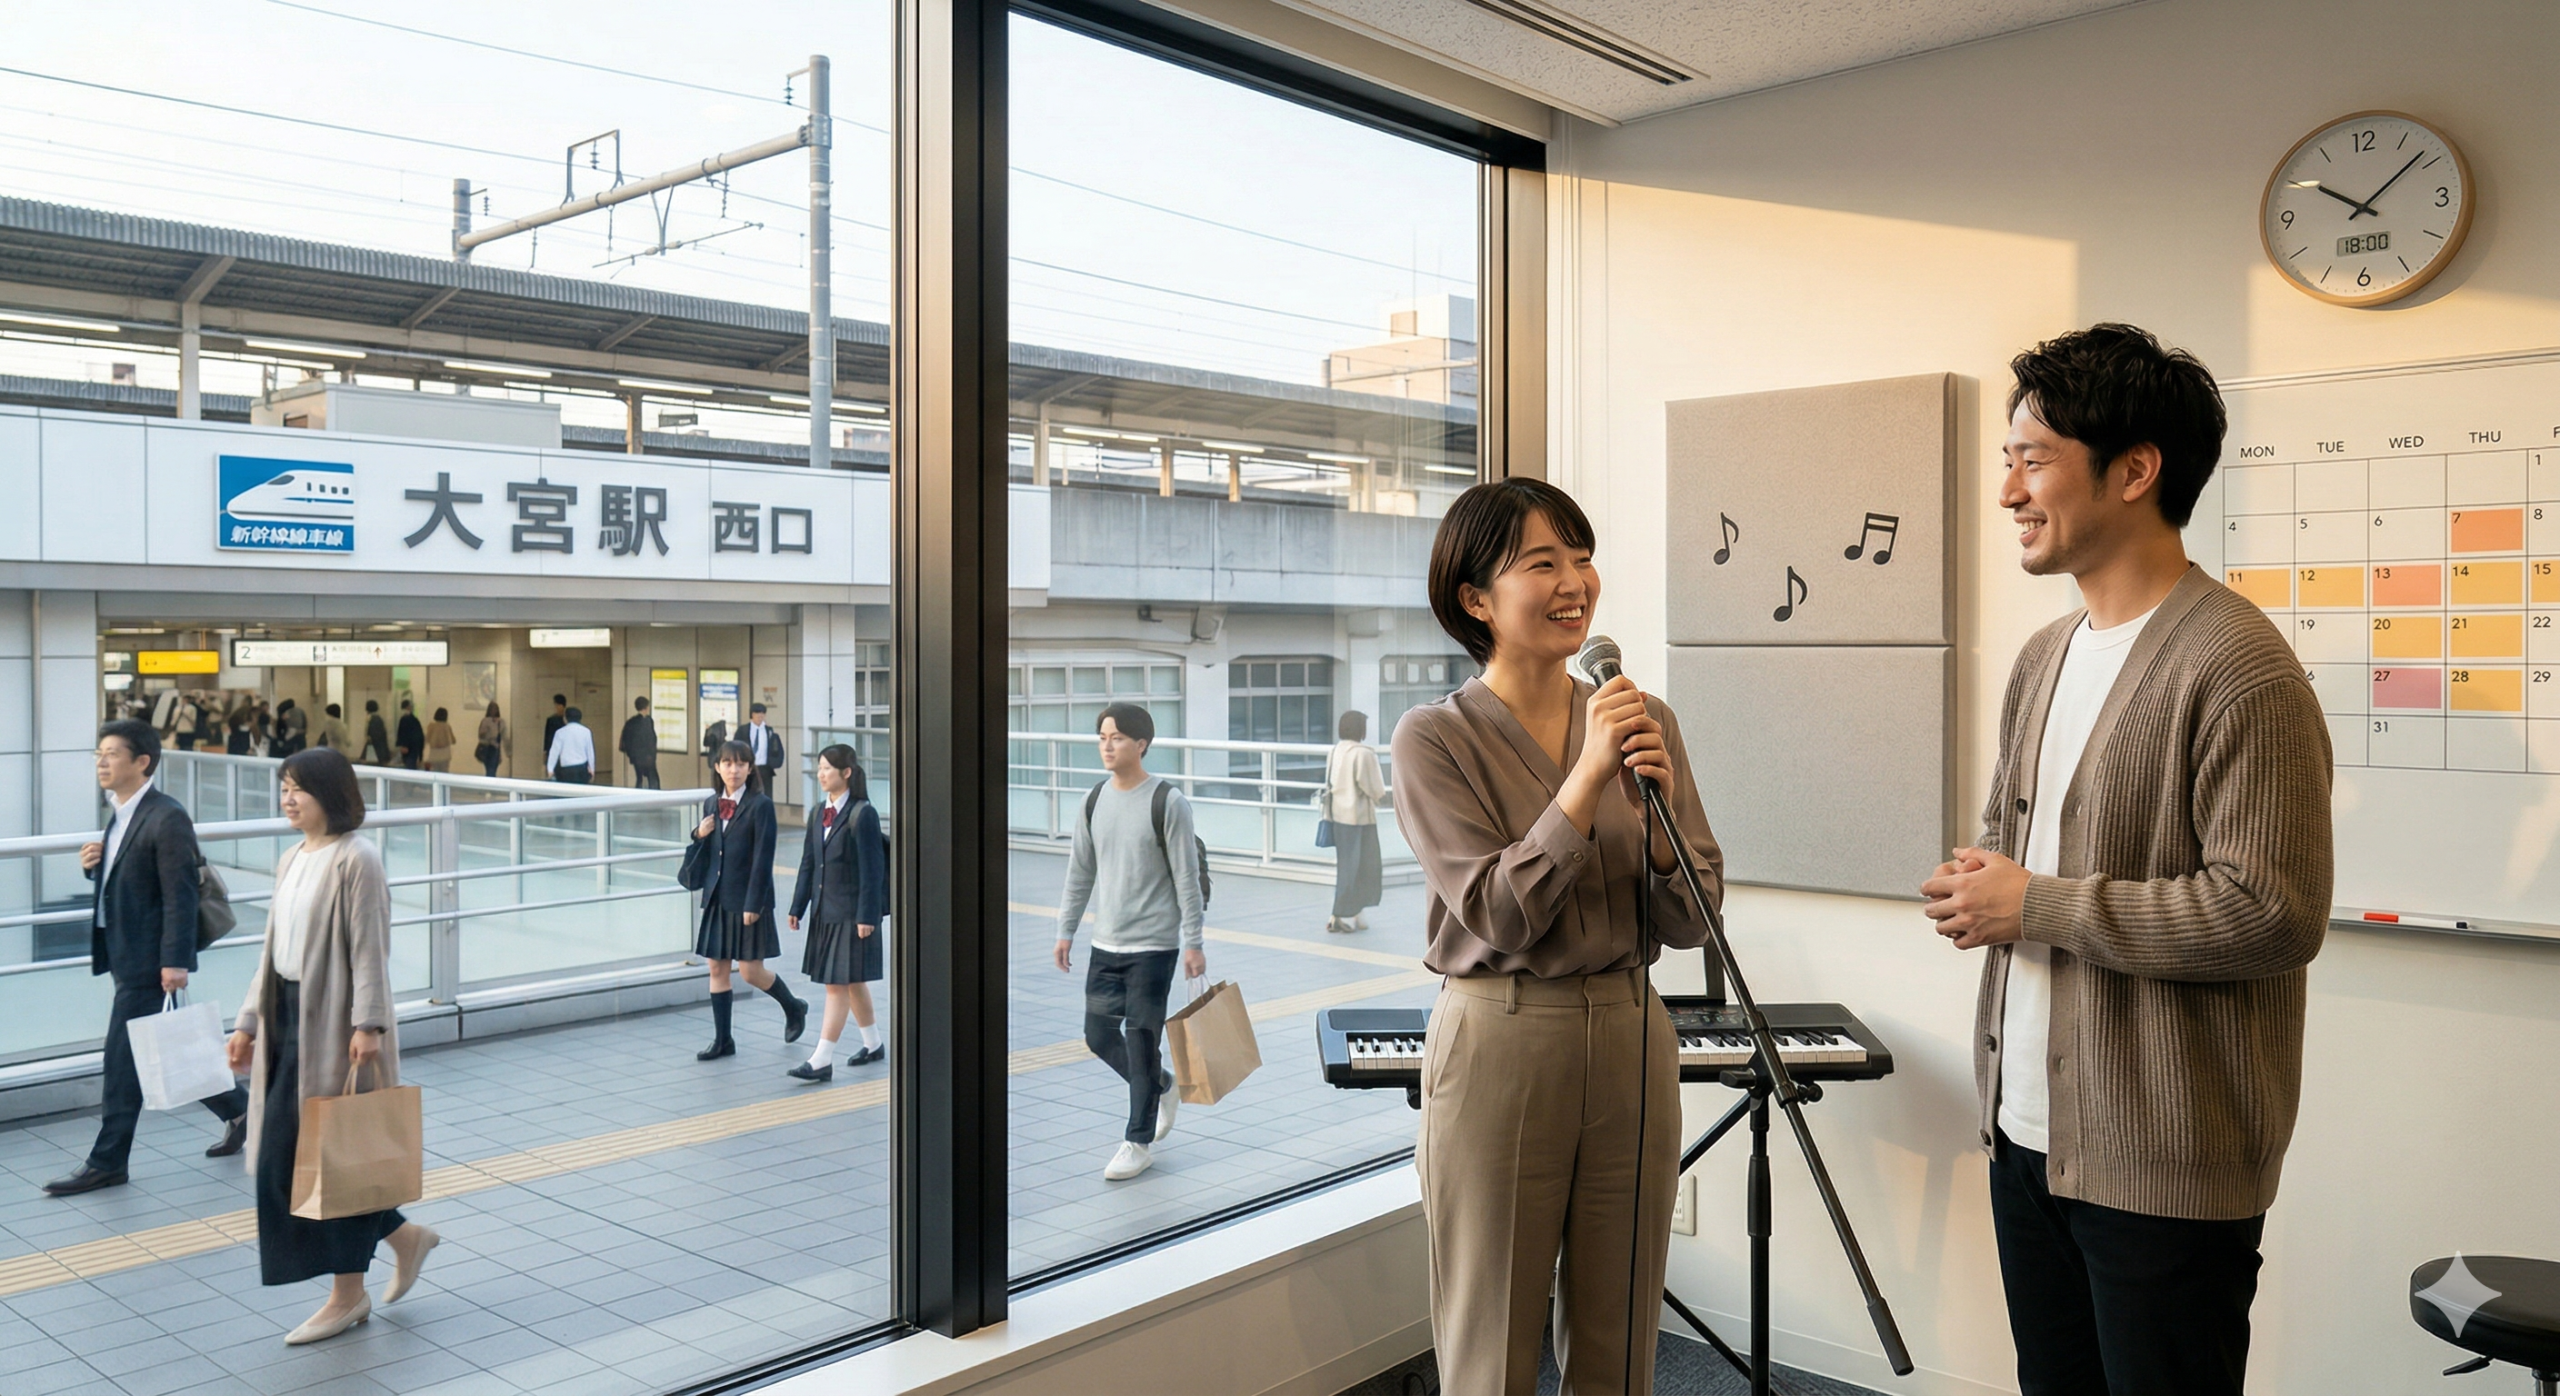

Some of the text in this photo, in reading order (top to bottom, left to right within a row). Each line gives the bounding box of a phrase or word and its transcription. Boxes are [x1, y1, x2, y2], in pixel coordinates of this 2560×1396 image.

[2352, 131, 2375, 152] 12
[2435, 187, 2449, 207] 3
[2281, 211, 2294, 230] 9
[2345, 234, 2389, 254] 18:00
[2357, 267, 2371, 286] 6
[2241, 447, 2274, 458] MON
[2317, 441, 2344, 453] TUE
[2389, 436, 2424, 448] WED
[2469, 431, 2501, 443] THU
[2534, 454, 2540, 465] 1
[404, 472, 812, 556] 大宮駅 西口
[2452, 513, 2460, 523] 7
[2534, 509, 2542, 520] 8
[2300, 519, 2308, 530] 5
[2375, 516, 2382, 526] 6
[2228, 522, 2237, 532] 4
[2375, 568, 2390, 579] 13
[2453, 566, 2469, 576] 14
[2536, 564, 2551, 574] 15
[2229, 572, 2242, 583] 11
[2300, 570, 2315, 581] 12
[2300, 620, 2315, 630] 19
[2374, 619, 2390, 629] 20
[2452, 618, 2466, 629] 21
[2533, 616, 2550, 627] 22
[241, 646, 251, 660] 2
[2374, 671, 2390, 681] 27
[2452, 671, 2469, 682] 28
[2534, 671, 2551, 682] 29
[2374, 722, 2387, 732] 31
